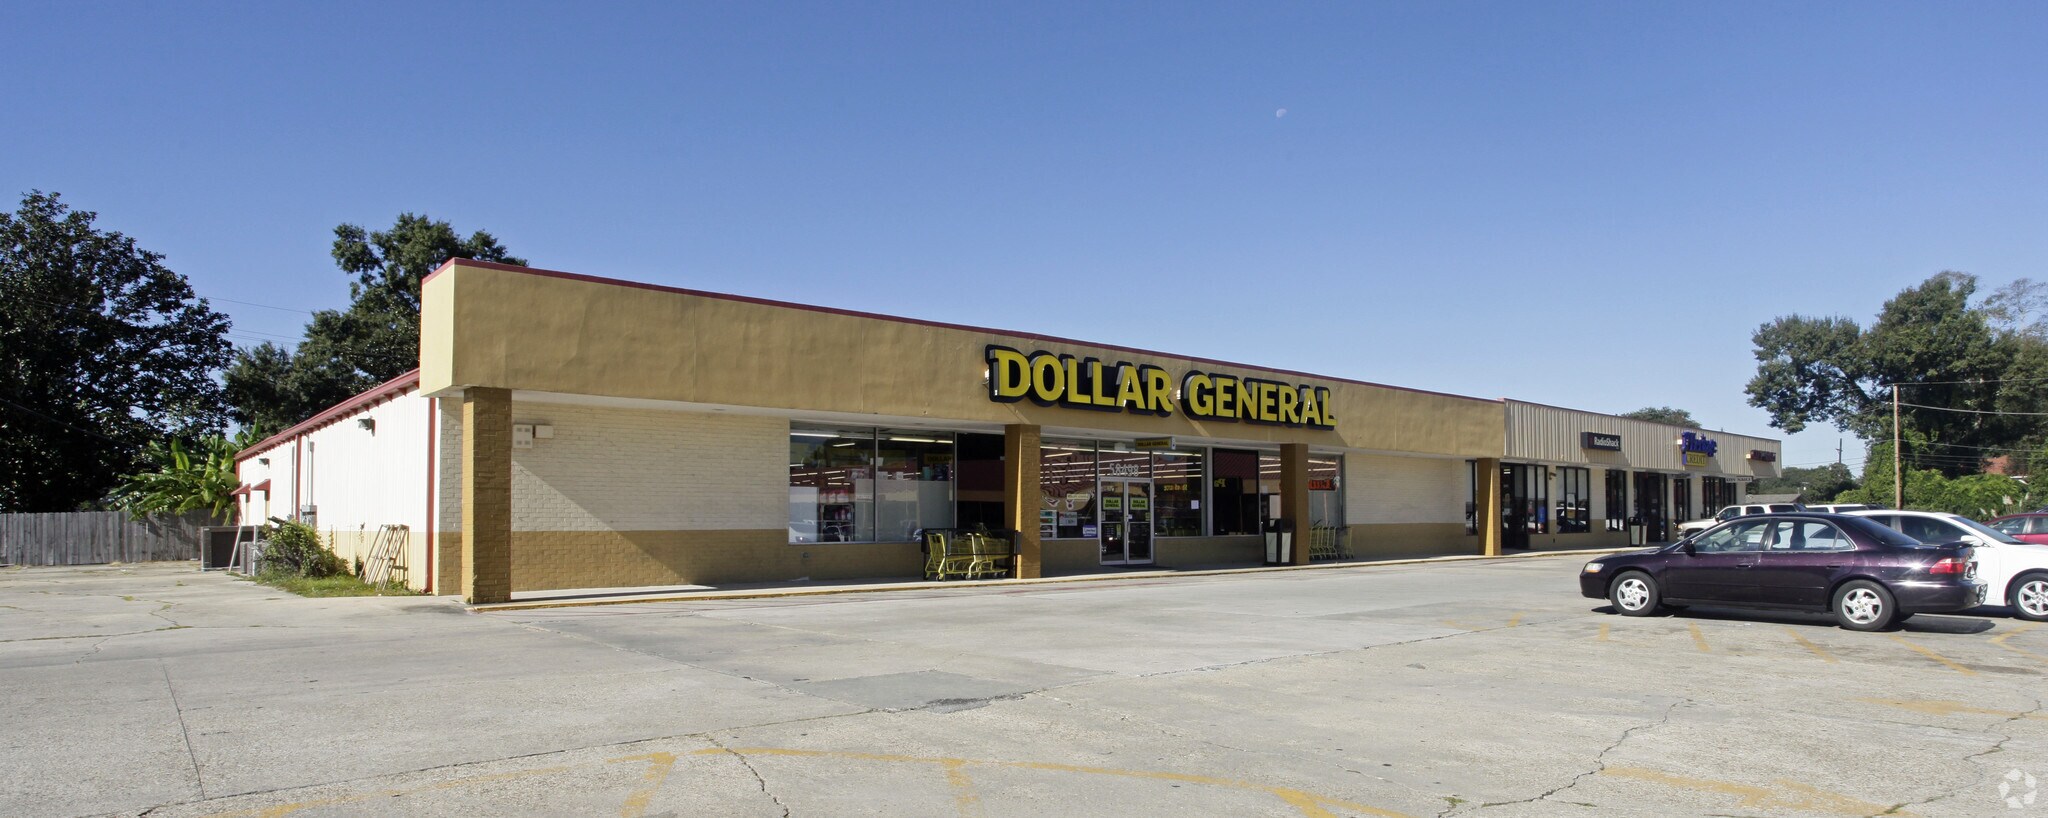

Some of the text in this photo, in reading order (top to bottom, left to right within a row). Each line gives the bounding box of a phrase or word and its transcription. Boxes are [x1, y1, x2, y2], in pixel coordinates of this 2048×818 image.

[992, 348, 1338, 427] DOLLAR GENERAL
[1593, 436, 1620, 447] RadioShack
[1109, 463, 1139, 477] 58498
